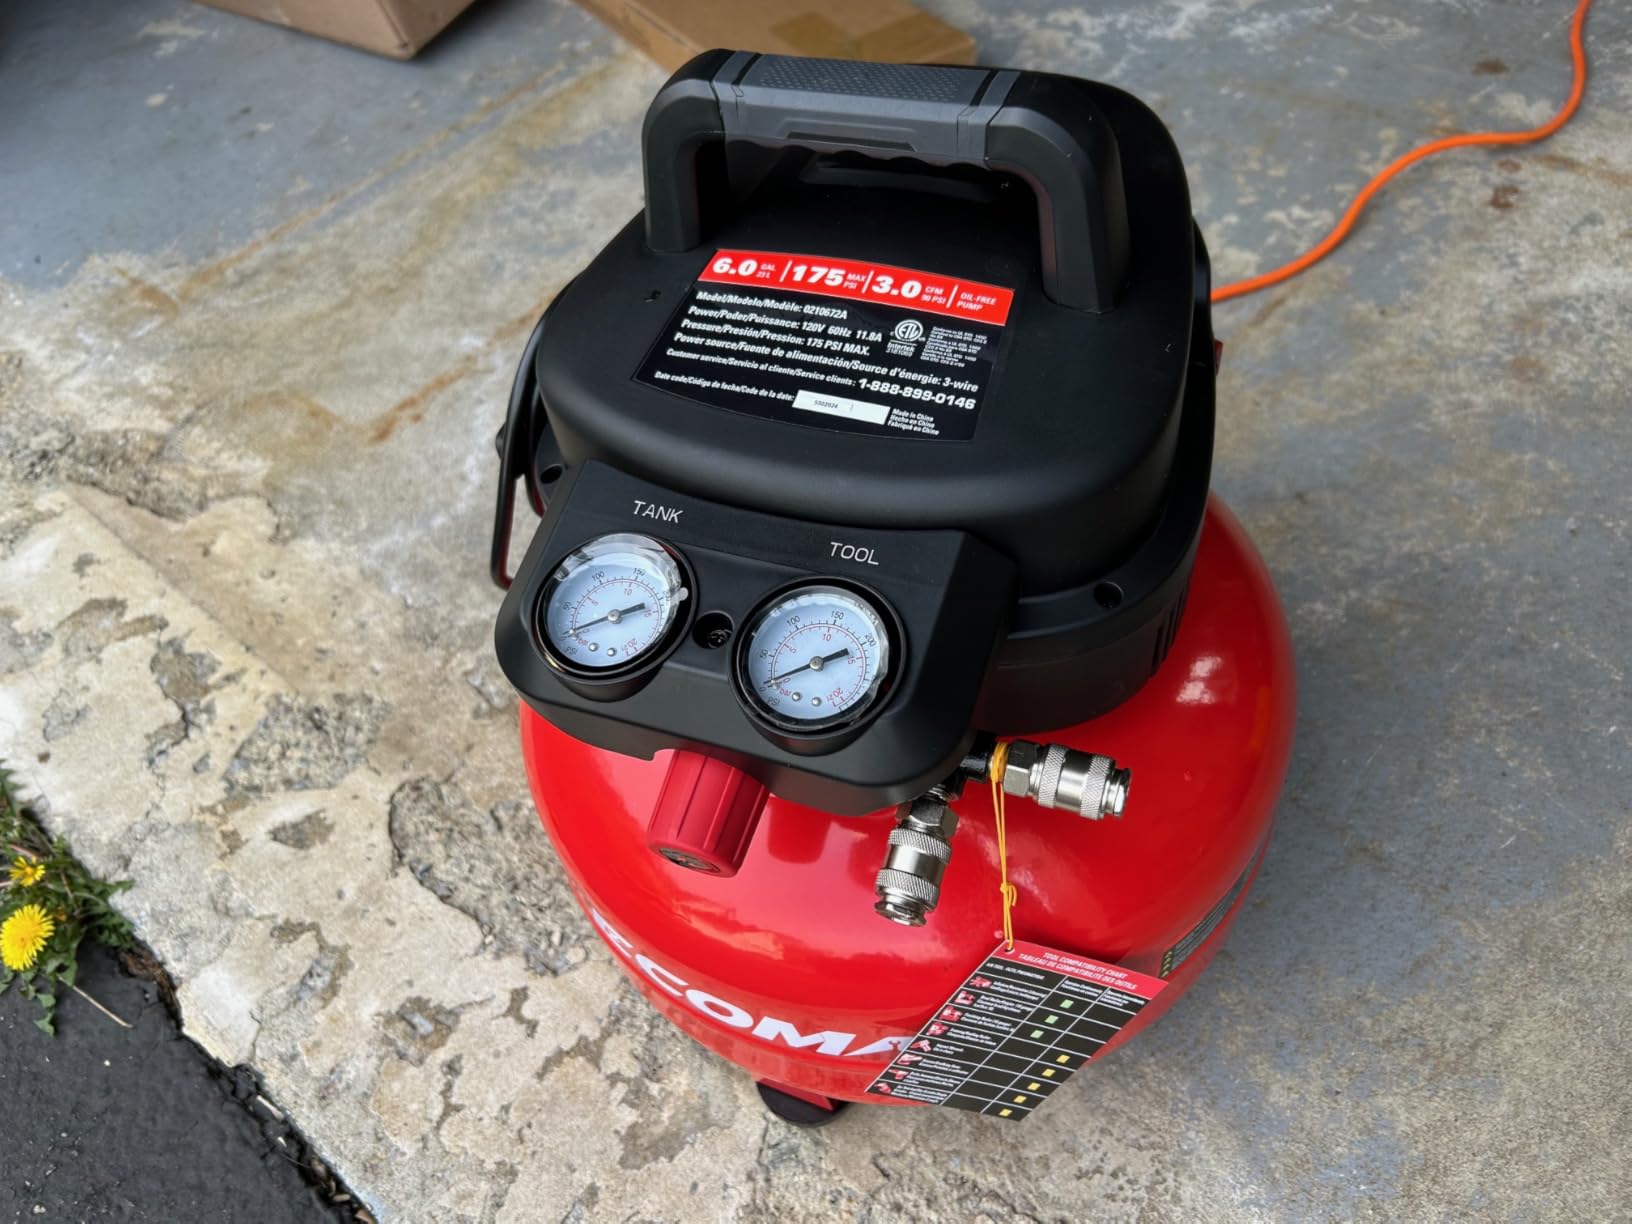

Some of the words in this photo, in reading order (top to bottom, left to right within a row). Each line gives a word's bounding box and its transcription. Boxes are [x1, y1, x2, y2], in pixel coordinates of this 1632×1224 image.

[713, 257, 758, 277] 6.0
[793, 265, 846, 286] 175
[847, 273, 866, 282] MAX
[843, 281, 857, 289] PSI
[872, 275, 922, 298] 3.0
[925, 286, 945, 295] CFM
[696, 291, 802, 313] Model/Modelo/Modèle:
[803, 304, 848, 320] 0210672A
[921, 294, 931, 302] 90
[931, 296, 947, 305] PSI
[956, 301, 983, 311] PUMP
[960, 292, 997, 305] OIL-FREE
[688, 305, 800, 329] Power/Poder/Puissance:
[801, 321, 826, 333] 120V
[827, 325, 852, 338] 60Hz
[856, 330, 883, 342] 11.8A
[681, 318, 805, 345] Pressure/Presión/Pression:
[806, 337, 824, 349] 175
[824, 341, 843, 352] PSI
[843, 344, 871, 356] MAX.
[887, 342, 916, 352] Intertek
[673, 332, 704, 346] Power
[704, 338, 770, 355] source/Fuente
[772, 346, 785, 358] de
[785, 349, 888, 375] alimentación/Source
[889, 366, 942, 387] d'énergie:
[942, 377, 979, 393] 3-wire
[654, 370, 671, 381] Date
[670, 374, 711, 388] code/Código
[711, 380, 721, 389] de
[721, 381, 759, 396] fecha/Code
[759, 388, 769, 397] de
[769, 389, 777, 399] la
[777, 391, 795, 401] date:
[666, 348, 701, 360] Customer
[700, 353, 759, 369] service/Servicio
[759, 361, 768, 371] al
[768, 364, 825, 381] cliente/Service
[826, 373, 857, 387] clients:
[858, 377, 976, 410] 1-888-899-0146
[892, 408, 909, 417] Made
[909, 411, 916, 419] in
[634, 500, 683, 523] TANK
[830, 541, 880, 565] TOOL
[786, 615, 801, 625] 100
[830, 611, 845, 620] 150
[822, 634, 832, 642] 10
[767, 696, 780, 706] PSI
